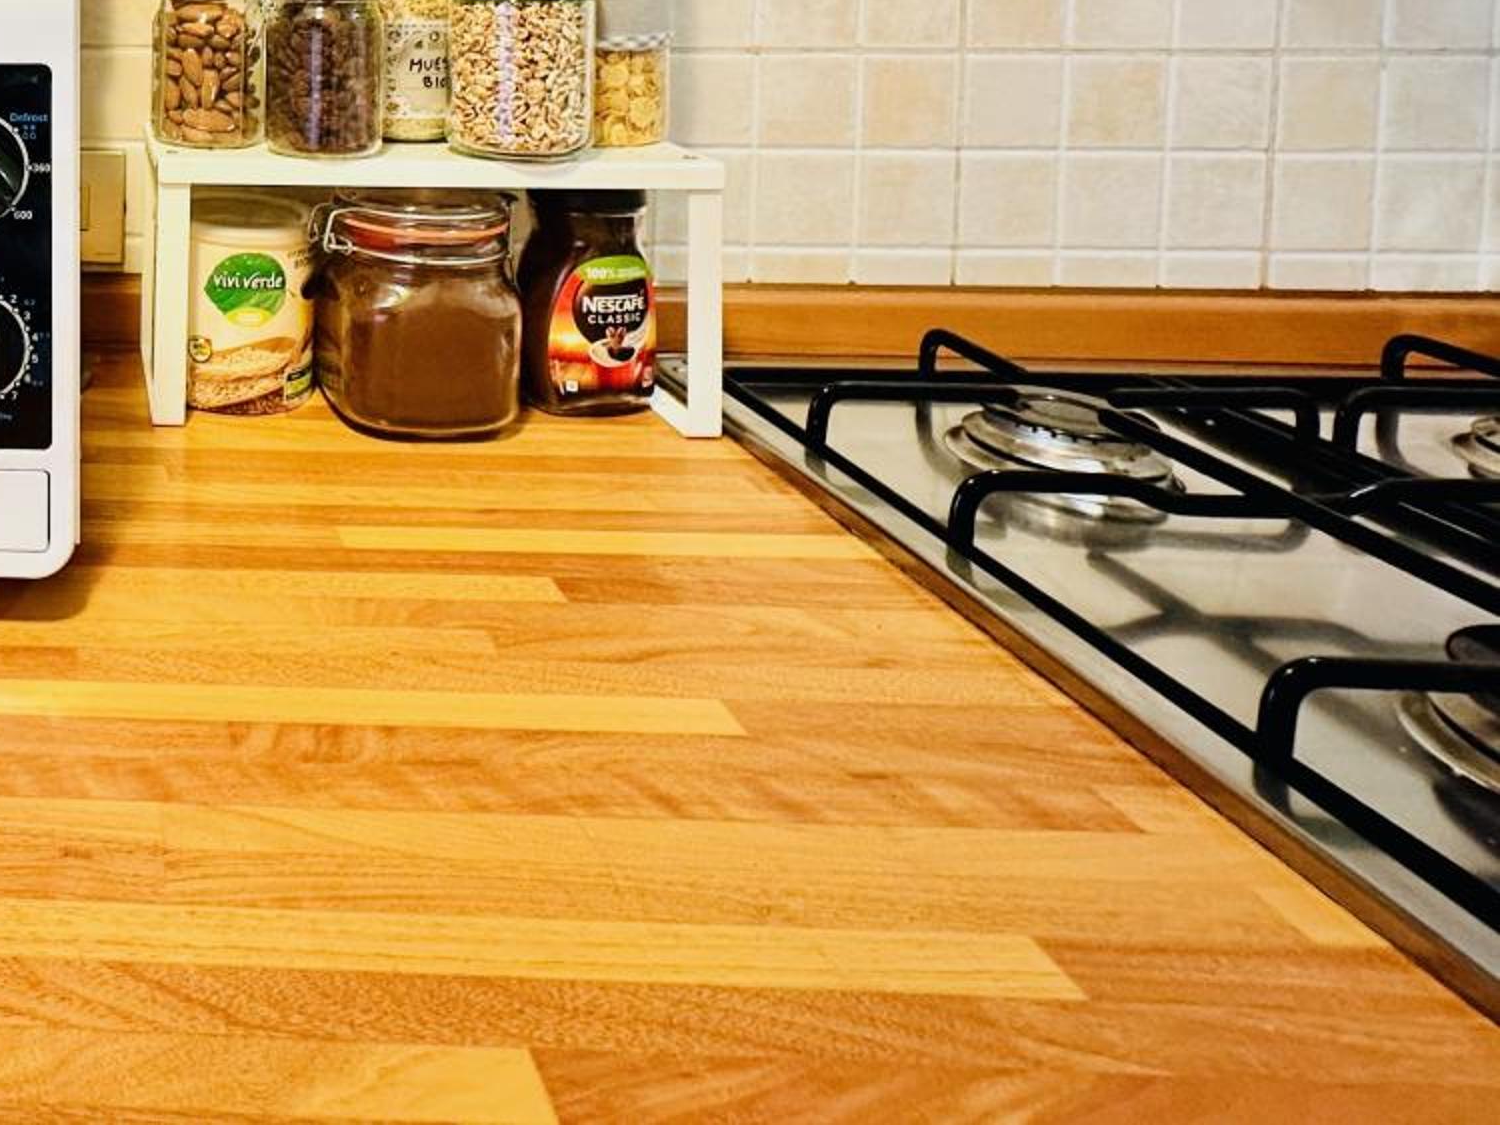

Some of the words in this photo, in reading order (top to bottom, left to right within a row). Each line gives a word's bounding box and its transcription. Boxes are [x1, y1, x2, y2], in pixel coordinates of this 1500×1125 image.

[9, 112, 49, 122] Defrost
[10, 294, 18, 304] 2
[587, 312, 641, 324] CLASSIC
